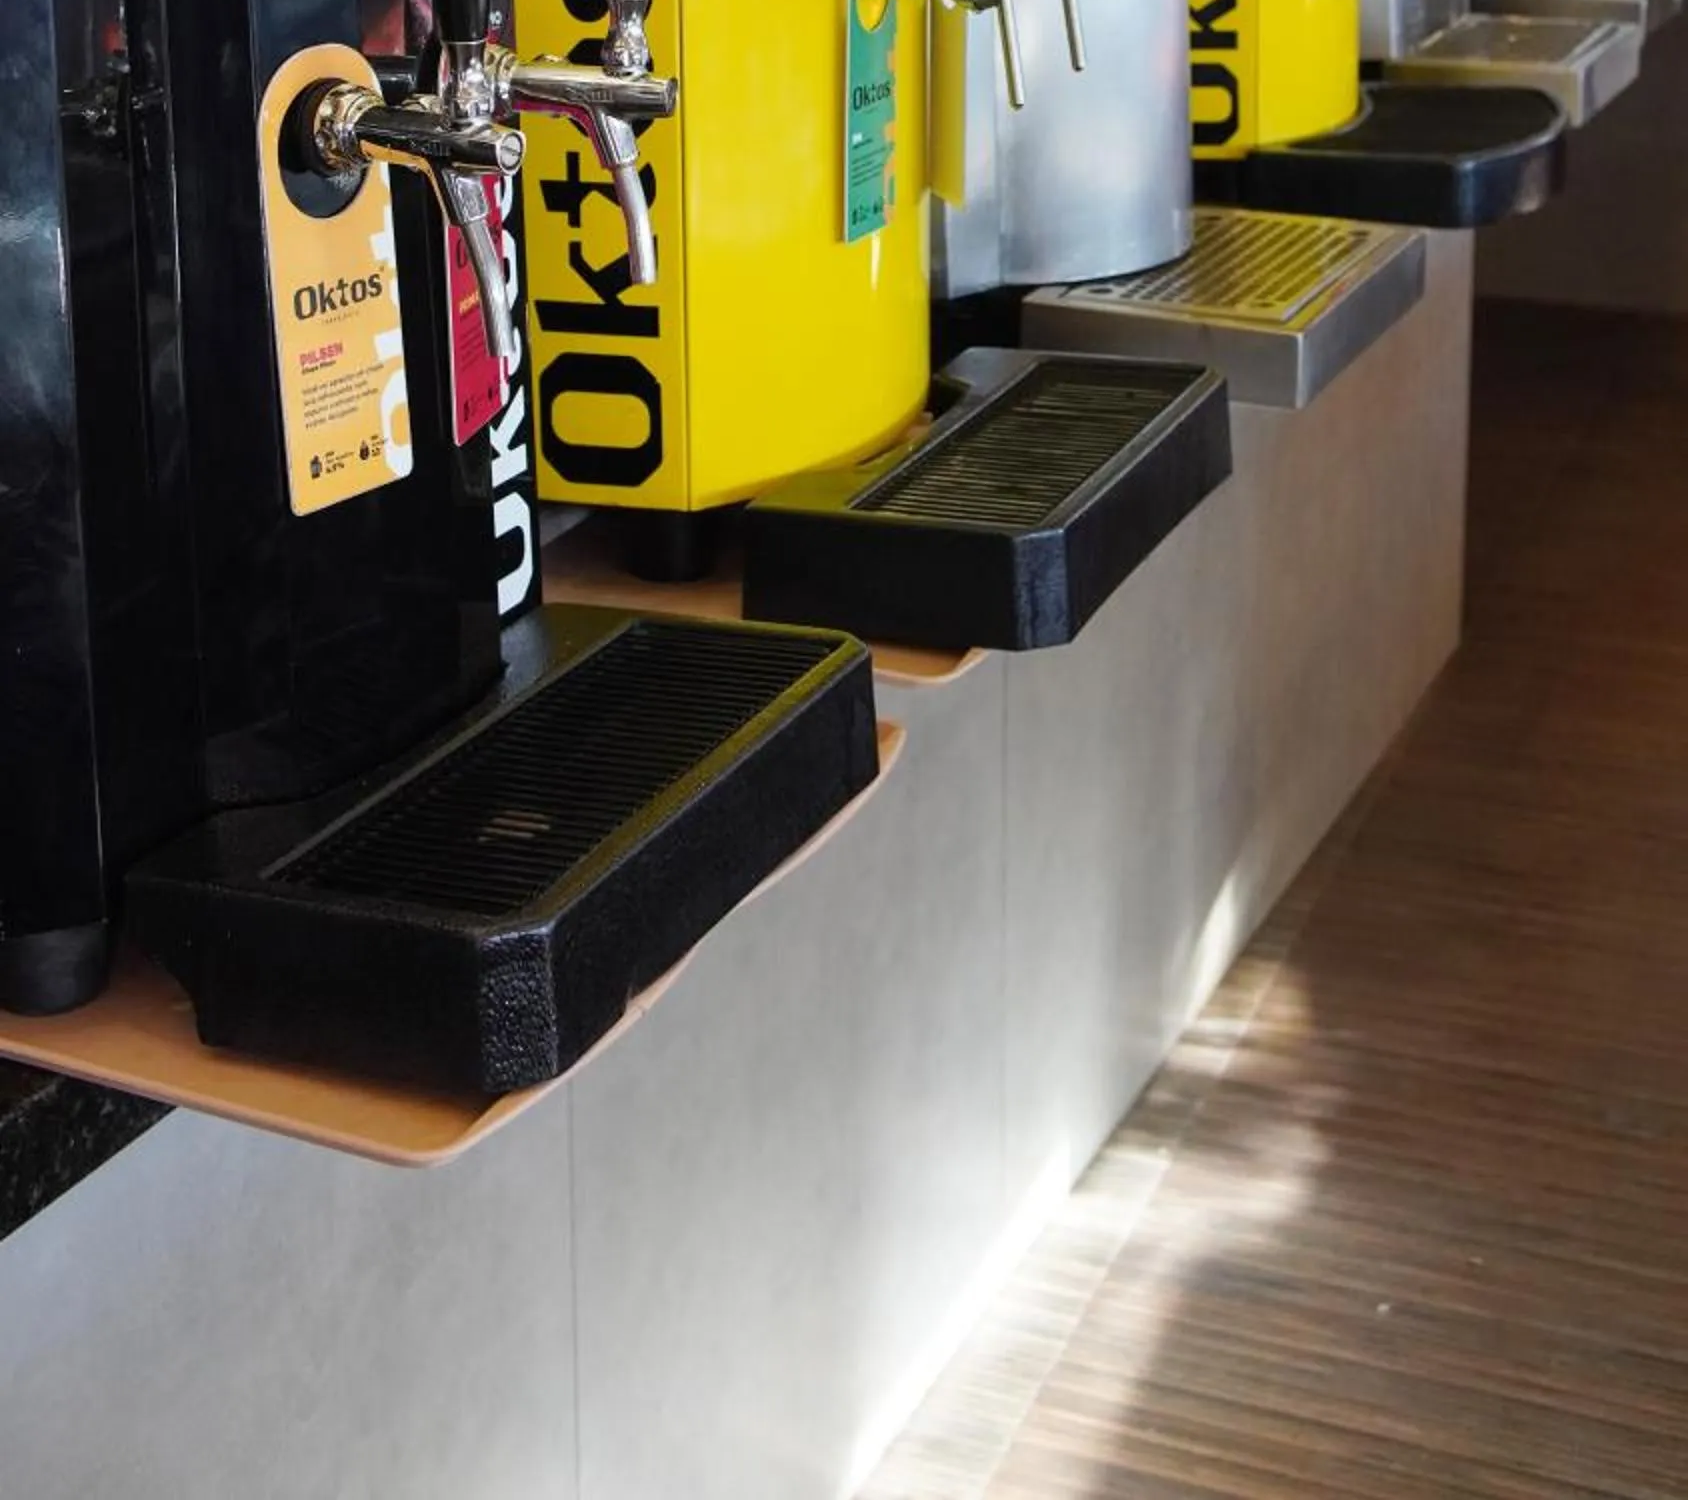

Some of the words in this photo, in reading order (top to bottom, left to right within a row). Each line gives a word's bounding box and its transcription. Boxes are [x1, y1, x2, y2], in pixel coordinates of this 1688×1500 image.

[853, 80, 891, 111] Oktos
[293, 273, 384, 321] Oktos
[300, 342, 343, 366] PILSEN
